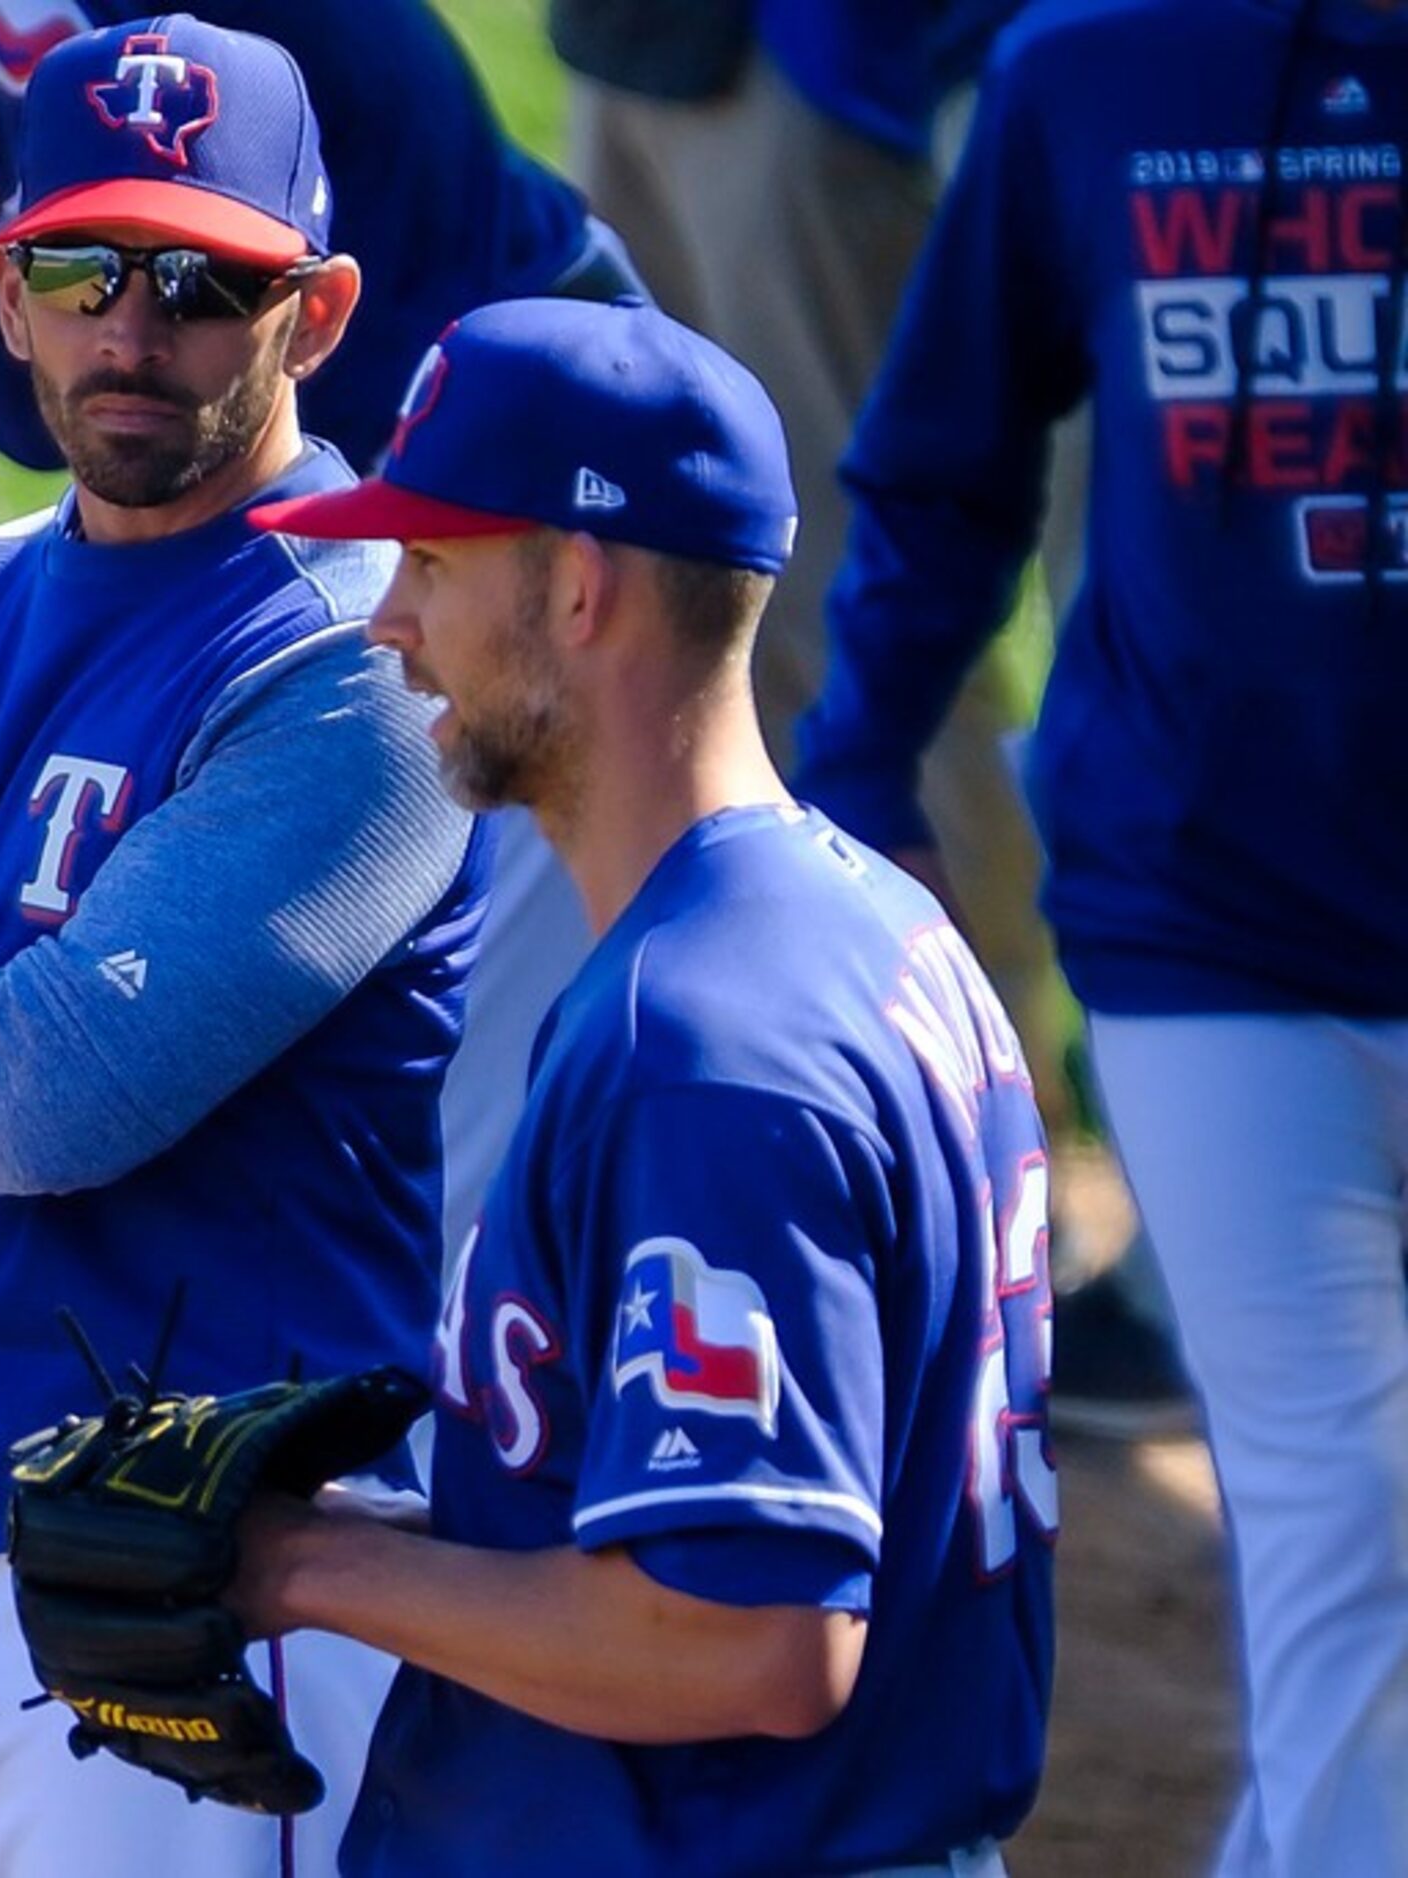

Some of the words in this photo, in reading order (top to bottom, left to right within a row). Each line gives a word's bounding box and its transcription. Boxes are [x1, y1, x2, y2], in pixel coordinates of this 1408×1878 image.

[115, 53, 190, 130] T
[1130, 150, 1220, 184] 2019
[1275, 144, 1404, 181] SPRING
[19, 753, 133, 923] T
